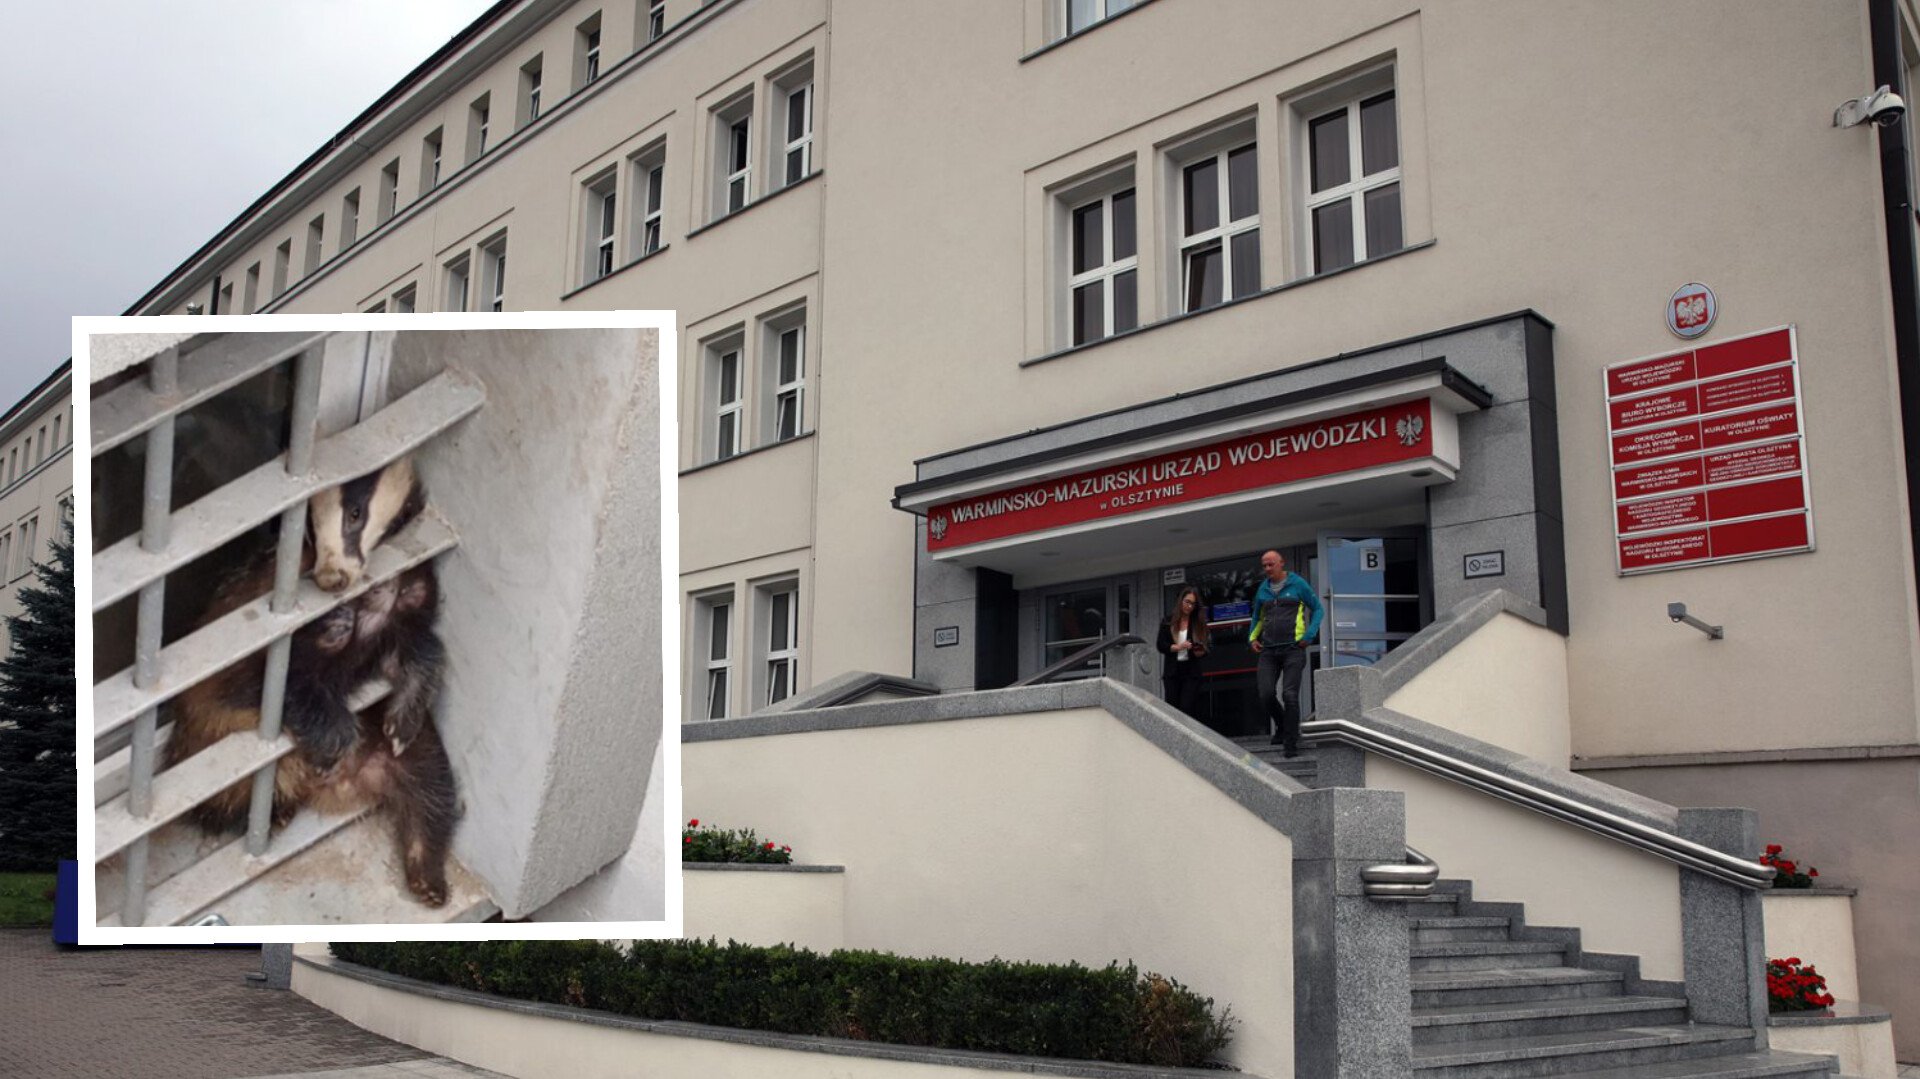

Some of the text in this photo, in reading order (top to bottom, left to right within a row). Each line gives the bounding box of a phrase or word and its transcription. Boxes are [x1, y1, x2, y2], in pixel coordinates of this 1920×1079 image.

[1646, 401, 1687, 414] WYBORCZE
[1705, 412, 1794, 434] KURATORIUM OŚWIATY
[1152, 452, 1221, 483] URZĄD
[1228, 416, 1387, 466] WOJEWÓDZKI
[1619, 434, 1695, 453] KOMISJA WYBORCZA
[1111, 483, 1184, 508] OLSZTYNIE
[1366, 552, 1378, 568] B
